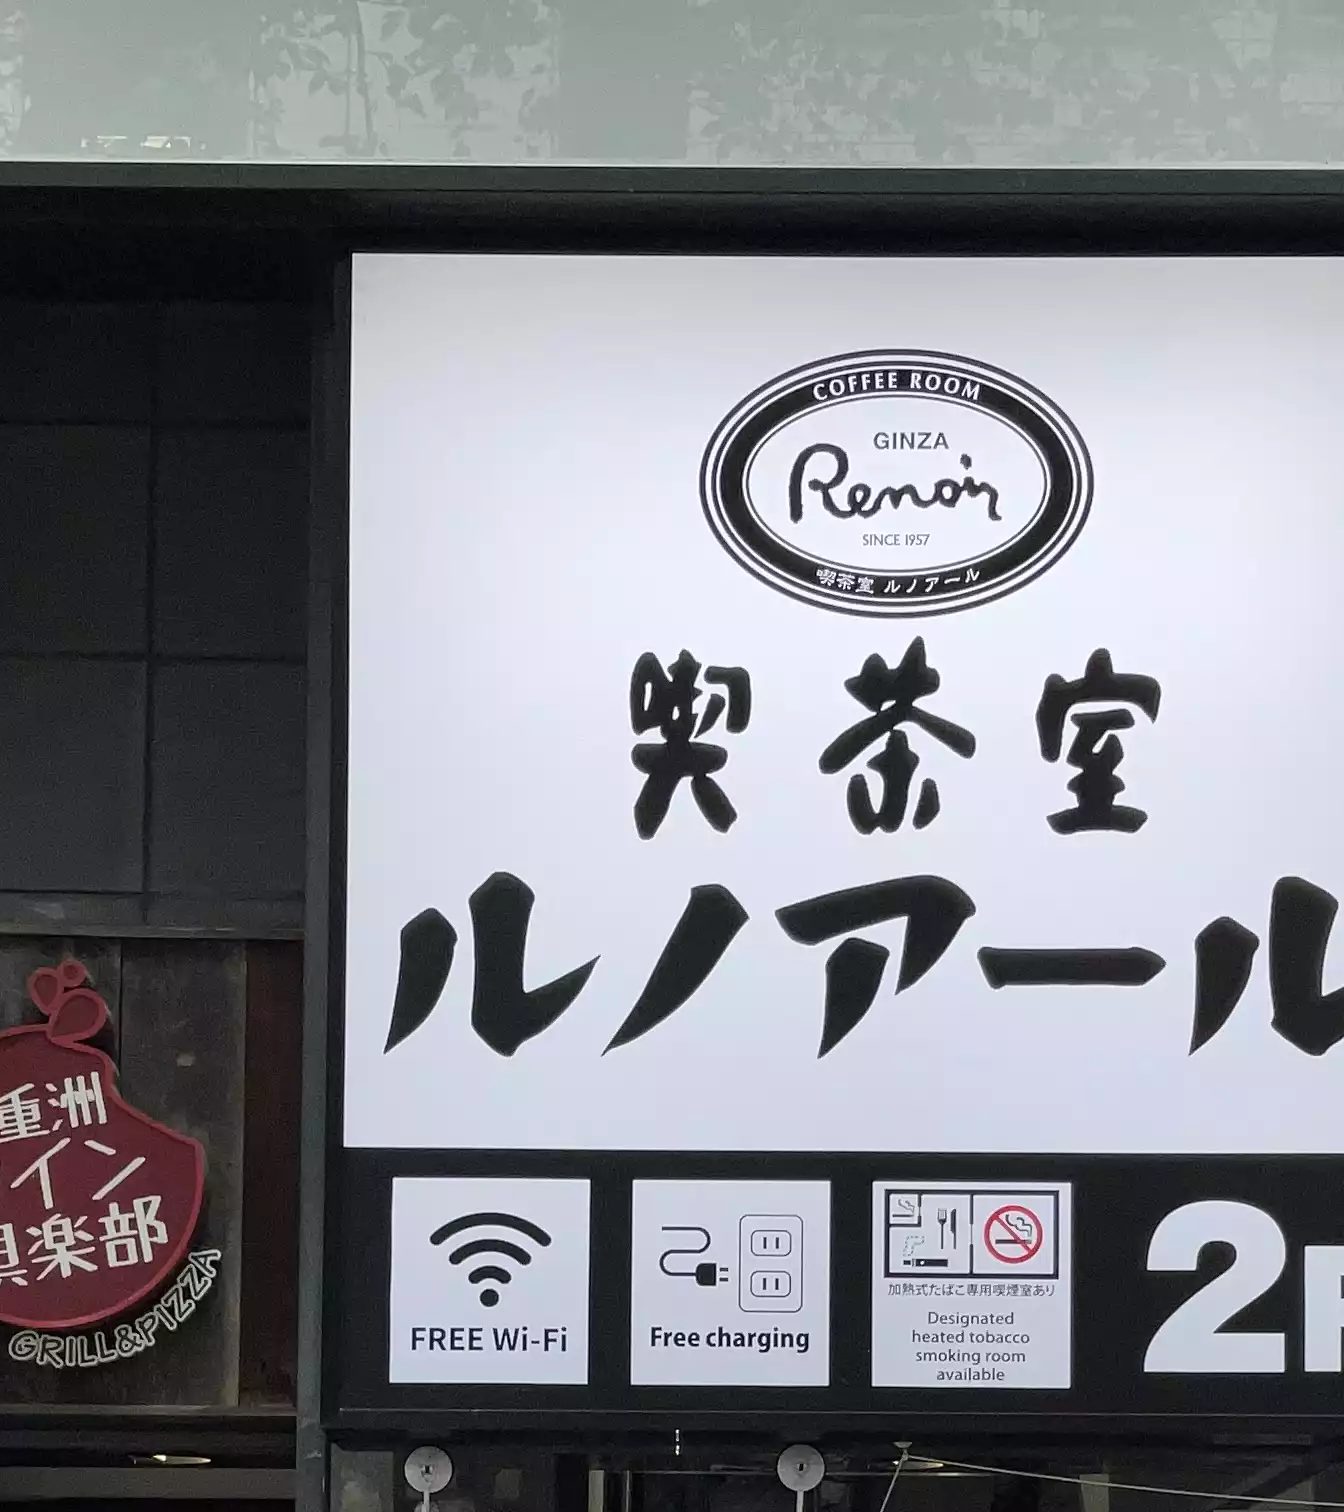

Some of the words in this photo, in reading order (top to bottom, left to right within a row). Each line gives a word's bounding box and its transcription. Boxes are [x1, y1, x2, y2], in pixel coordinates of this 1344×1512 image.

[813, 371, 898, 402] COFFEE
[910, 372, 981, 400] ROOM
[874, 432, 949, 450] GINZA
[789, 443, 1002, 523] Renoir
[862, 533, 900, 546] SINCE
[904, 533, 930, 546] 1957
[816, 569, 874, 595] 喫茶室
[884, 568, 981, 594] ルノアール
[630, 635, 1162, 841] 喫茶室
[888, 1282, 1056, 1298] 加熱式たばこ専用喫煙室あり
[8, 1248, 221, 1368] GRILL&PIZZA
[927, 1310, 1014, 1328] Designated
[411, 1327, 483, 1352] FREE
[493, 1326, 567, 1352] Wi-Fi
[650, 1326, 700, 1348] Free
[706, 1326, 810, 1353] charging
[912, 1329, 965, 1345] heated
[969, 1329, 1030, 1345] tobacco
[916, 1348, 982, 1365] smoking
[985, 1351, 1026, 1363] room
[936, 1367, 1005, 1383] available
